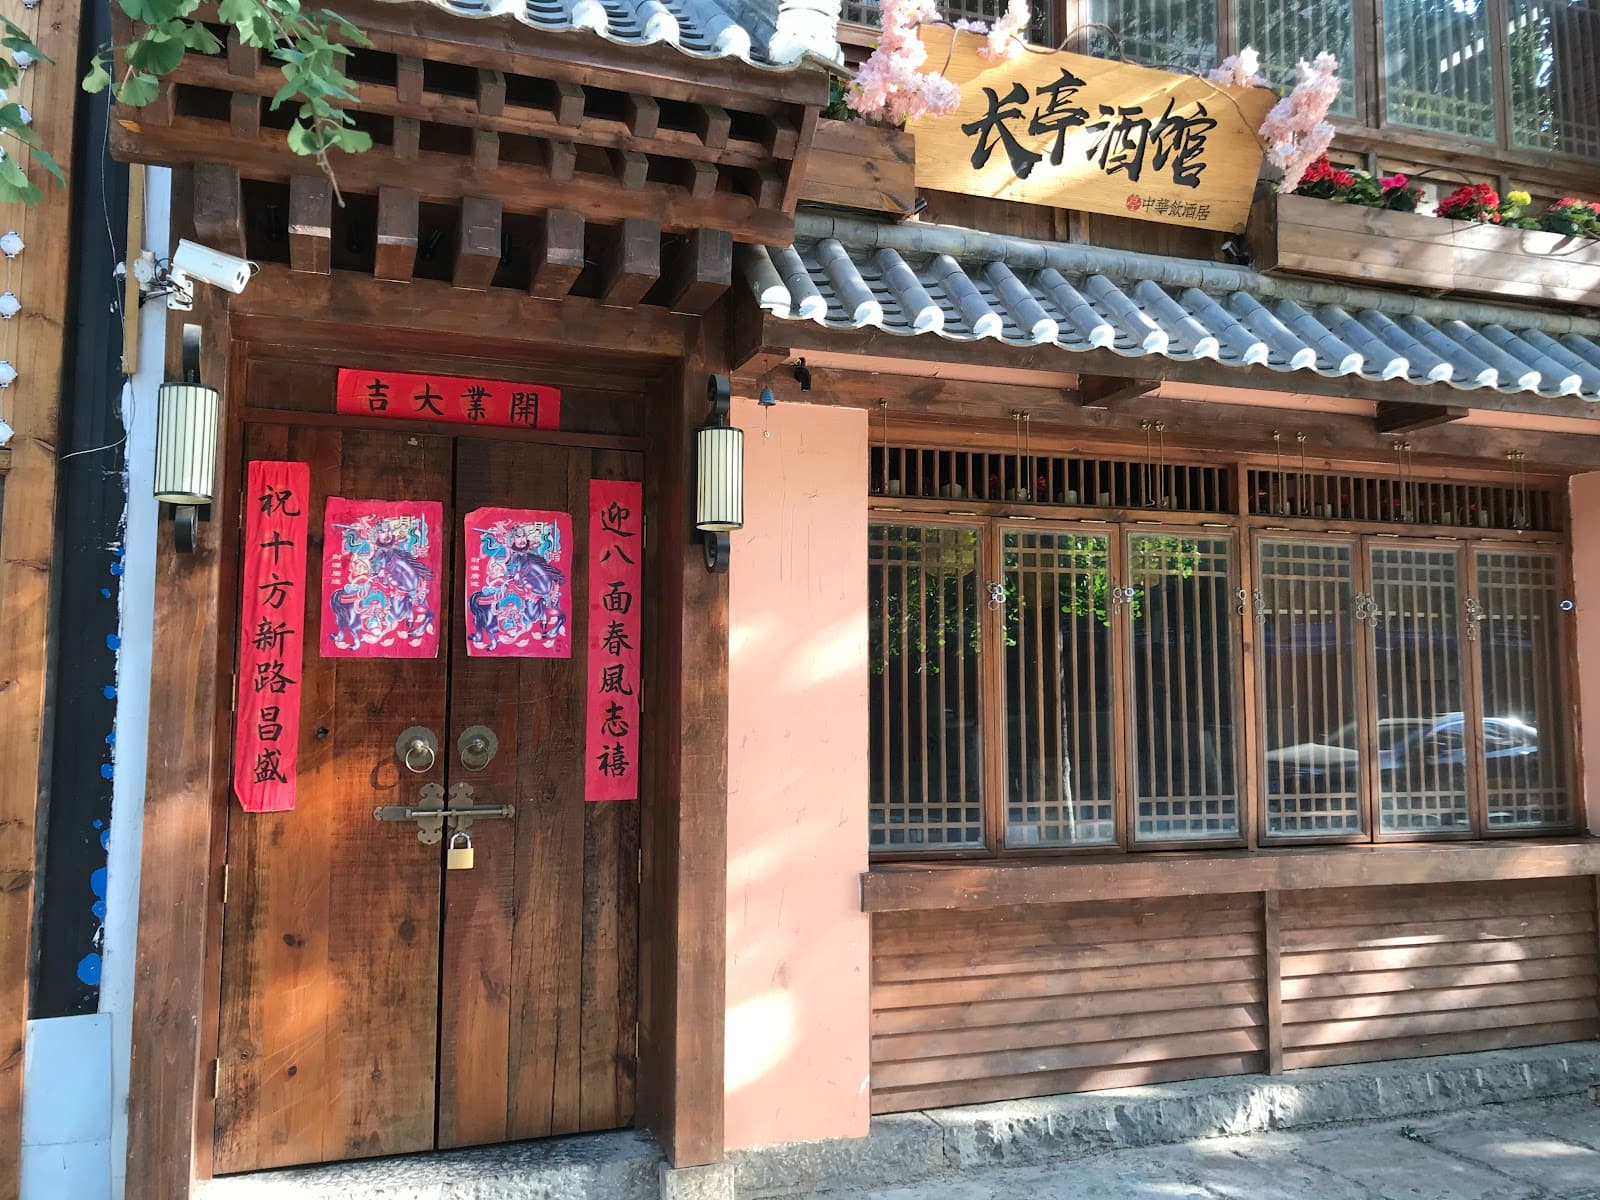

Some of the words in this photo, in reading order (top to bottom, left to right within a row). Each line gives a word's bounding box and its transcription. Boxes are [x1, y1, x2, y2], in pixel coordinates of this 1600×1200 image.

[961, 67, 1218, 189] 长亭酒馆
[1142, 195, 1211, 221] 中華飲酒居
[251, 485, 301, 784] 祝十方新路昌盛
[596, 501, 637, 778] 迎八面春風志禧
